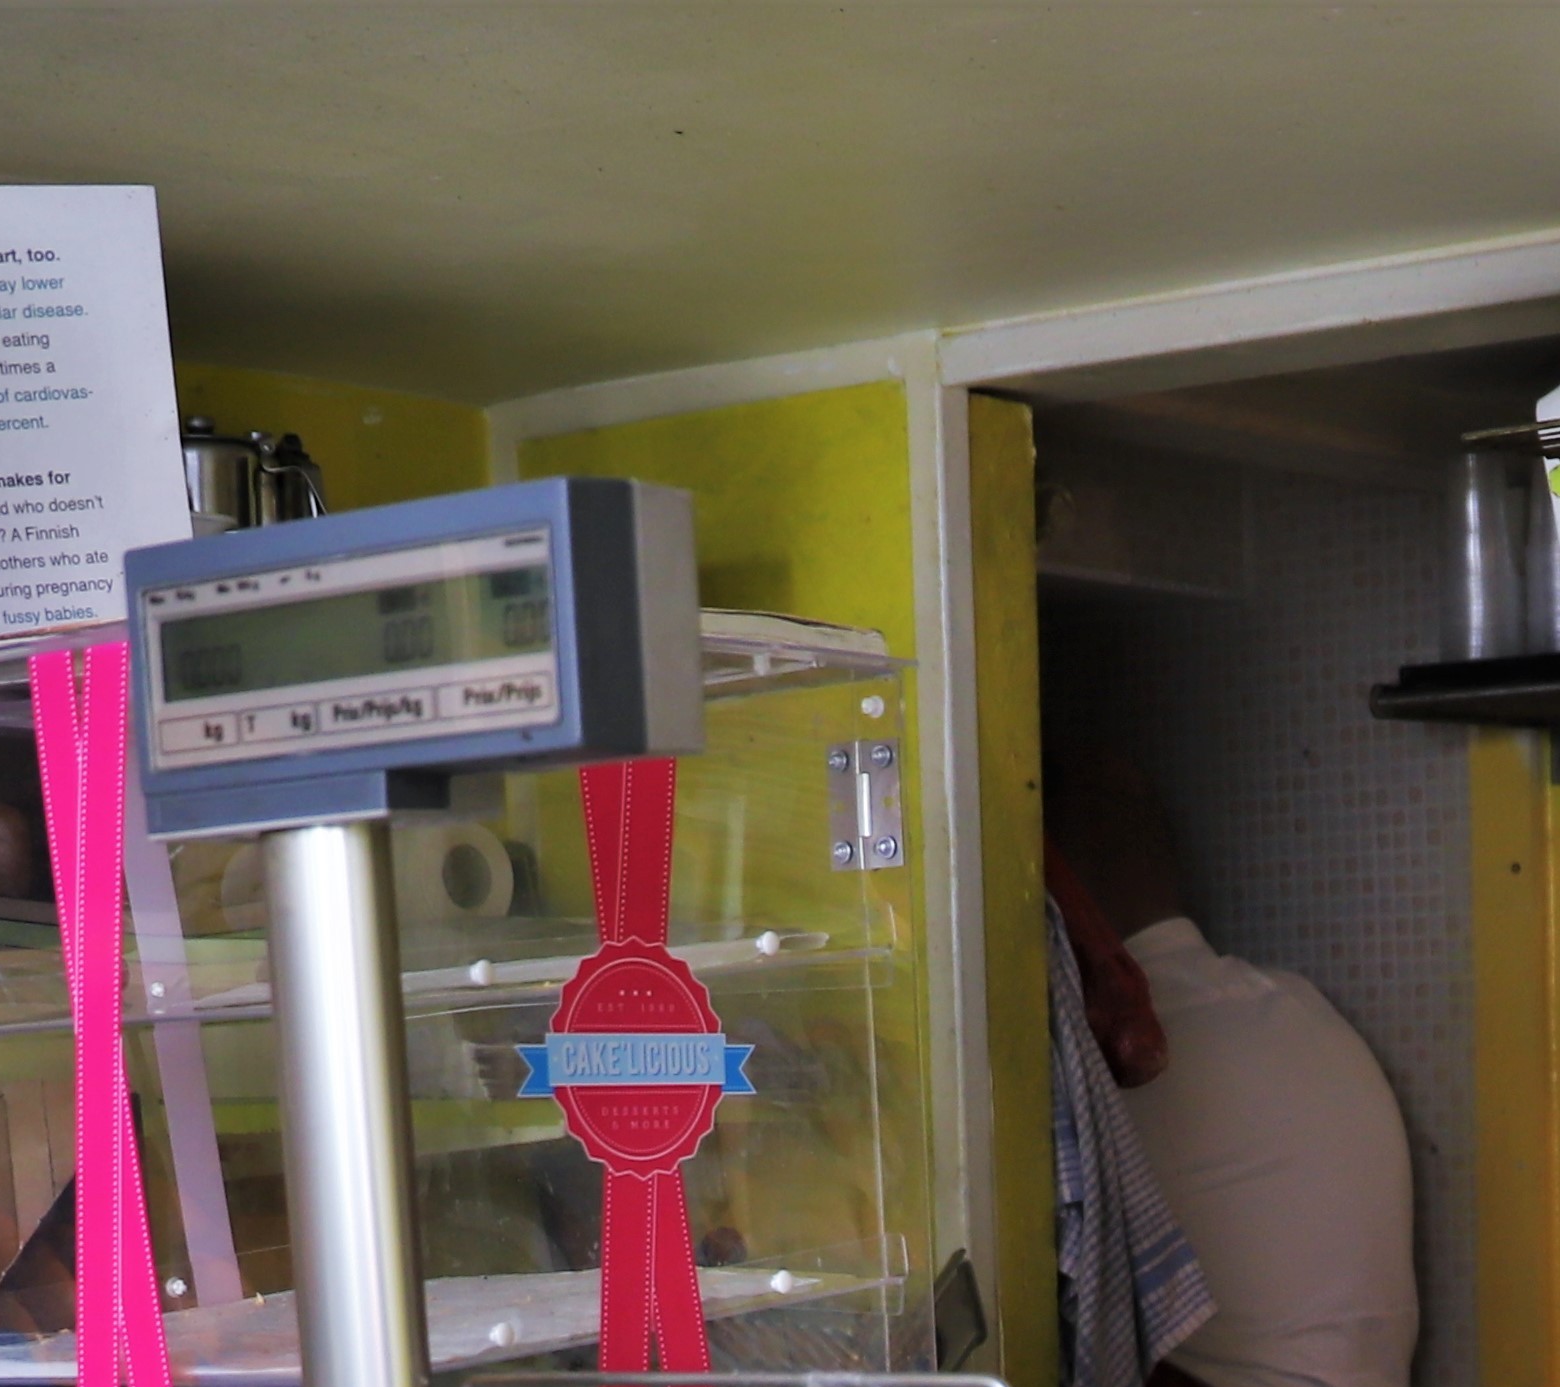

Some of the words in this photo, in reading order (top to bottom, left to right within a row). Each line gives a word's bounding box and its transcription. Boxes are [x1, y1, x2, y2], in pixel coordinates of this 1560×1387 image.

[26, 249, 59, 262] too.
[21, 276, 63, 290] lower
[22, 304, 87, 318] disease.
[2, 333, 49, 349] eating
[0, 361, 40, 375] times
[46, 362, 55, 373] a
[14, 387, 92, 402] cardiovas-
[47, 471, 69, 484] for
[13, 500, 43, 514] who
[48, 496, 102, 512] doesn't
[11, 528, 21, 542] A
[24, 524, 79, 541] Finnish
[49, 552, 80, 566] who
[85, 551, 108, 564] ate
[35, 579, 112, 598] pregnancy
[2, 610, 39, 626] fussy
[44, 606, 97, 621] babies.
[562, 1041, 712, 1076] CAKE'LICIOUS
